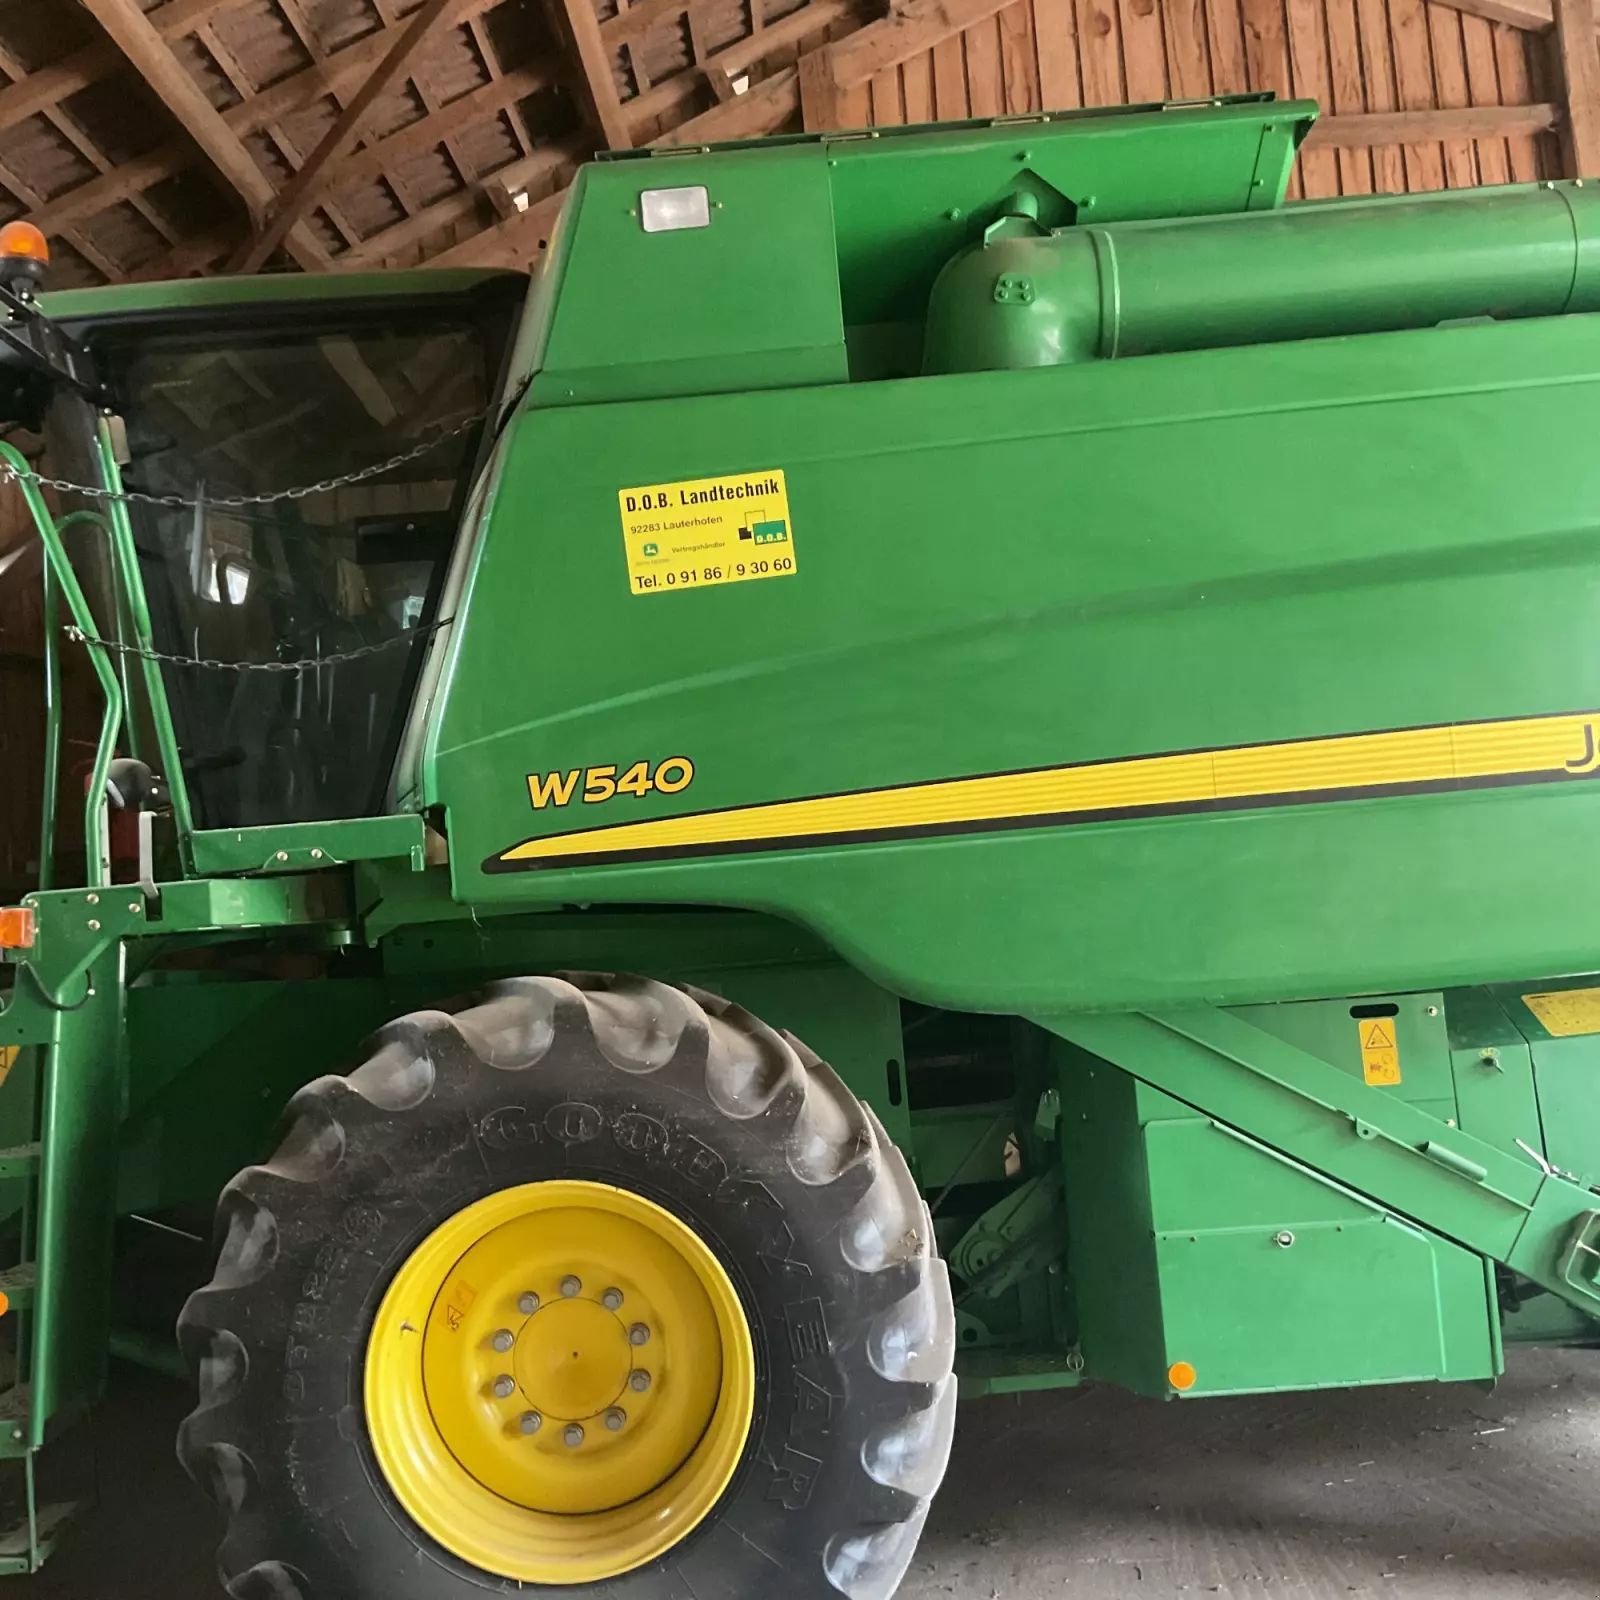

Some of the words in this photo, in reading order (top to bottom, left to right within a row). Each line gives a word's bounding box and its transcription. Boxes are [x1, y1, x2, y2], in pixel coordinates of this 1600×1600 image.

[626, 493, 674, 512] D.O.B.
[680, 479, 779, 505] Landtechnik
[630, 523, 661, 535] 92283
[663, 515, 723, 531] Lauterhofen
[635, 574, 662, 589] Tel.
[666, 572, 676, 585] 0
[680, 569, 697, 583] 91
[703, 566, 722, 581] 86
[736, 563, 746, 576] 9
[750, 560, 769, 574] 30
[773, 557, 792, 571] 60
[1565, 724, 1600, 767] J
[526, 755, 695, 811] W540
